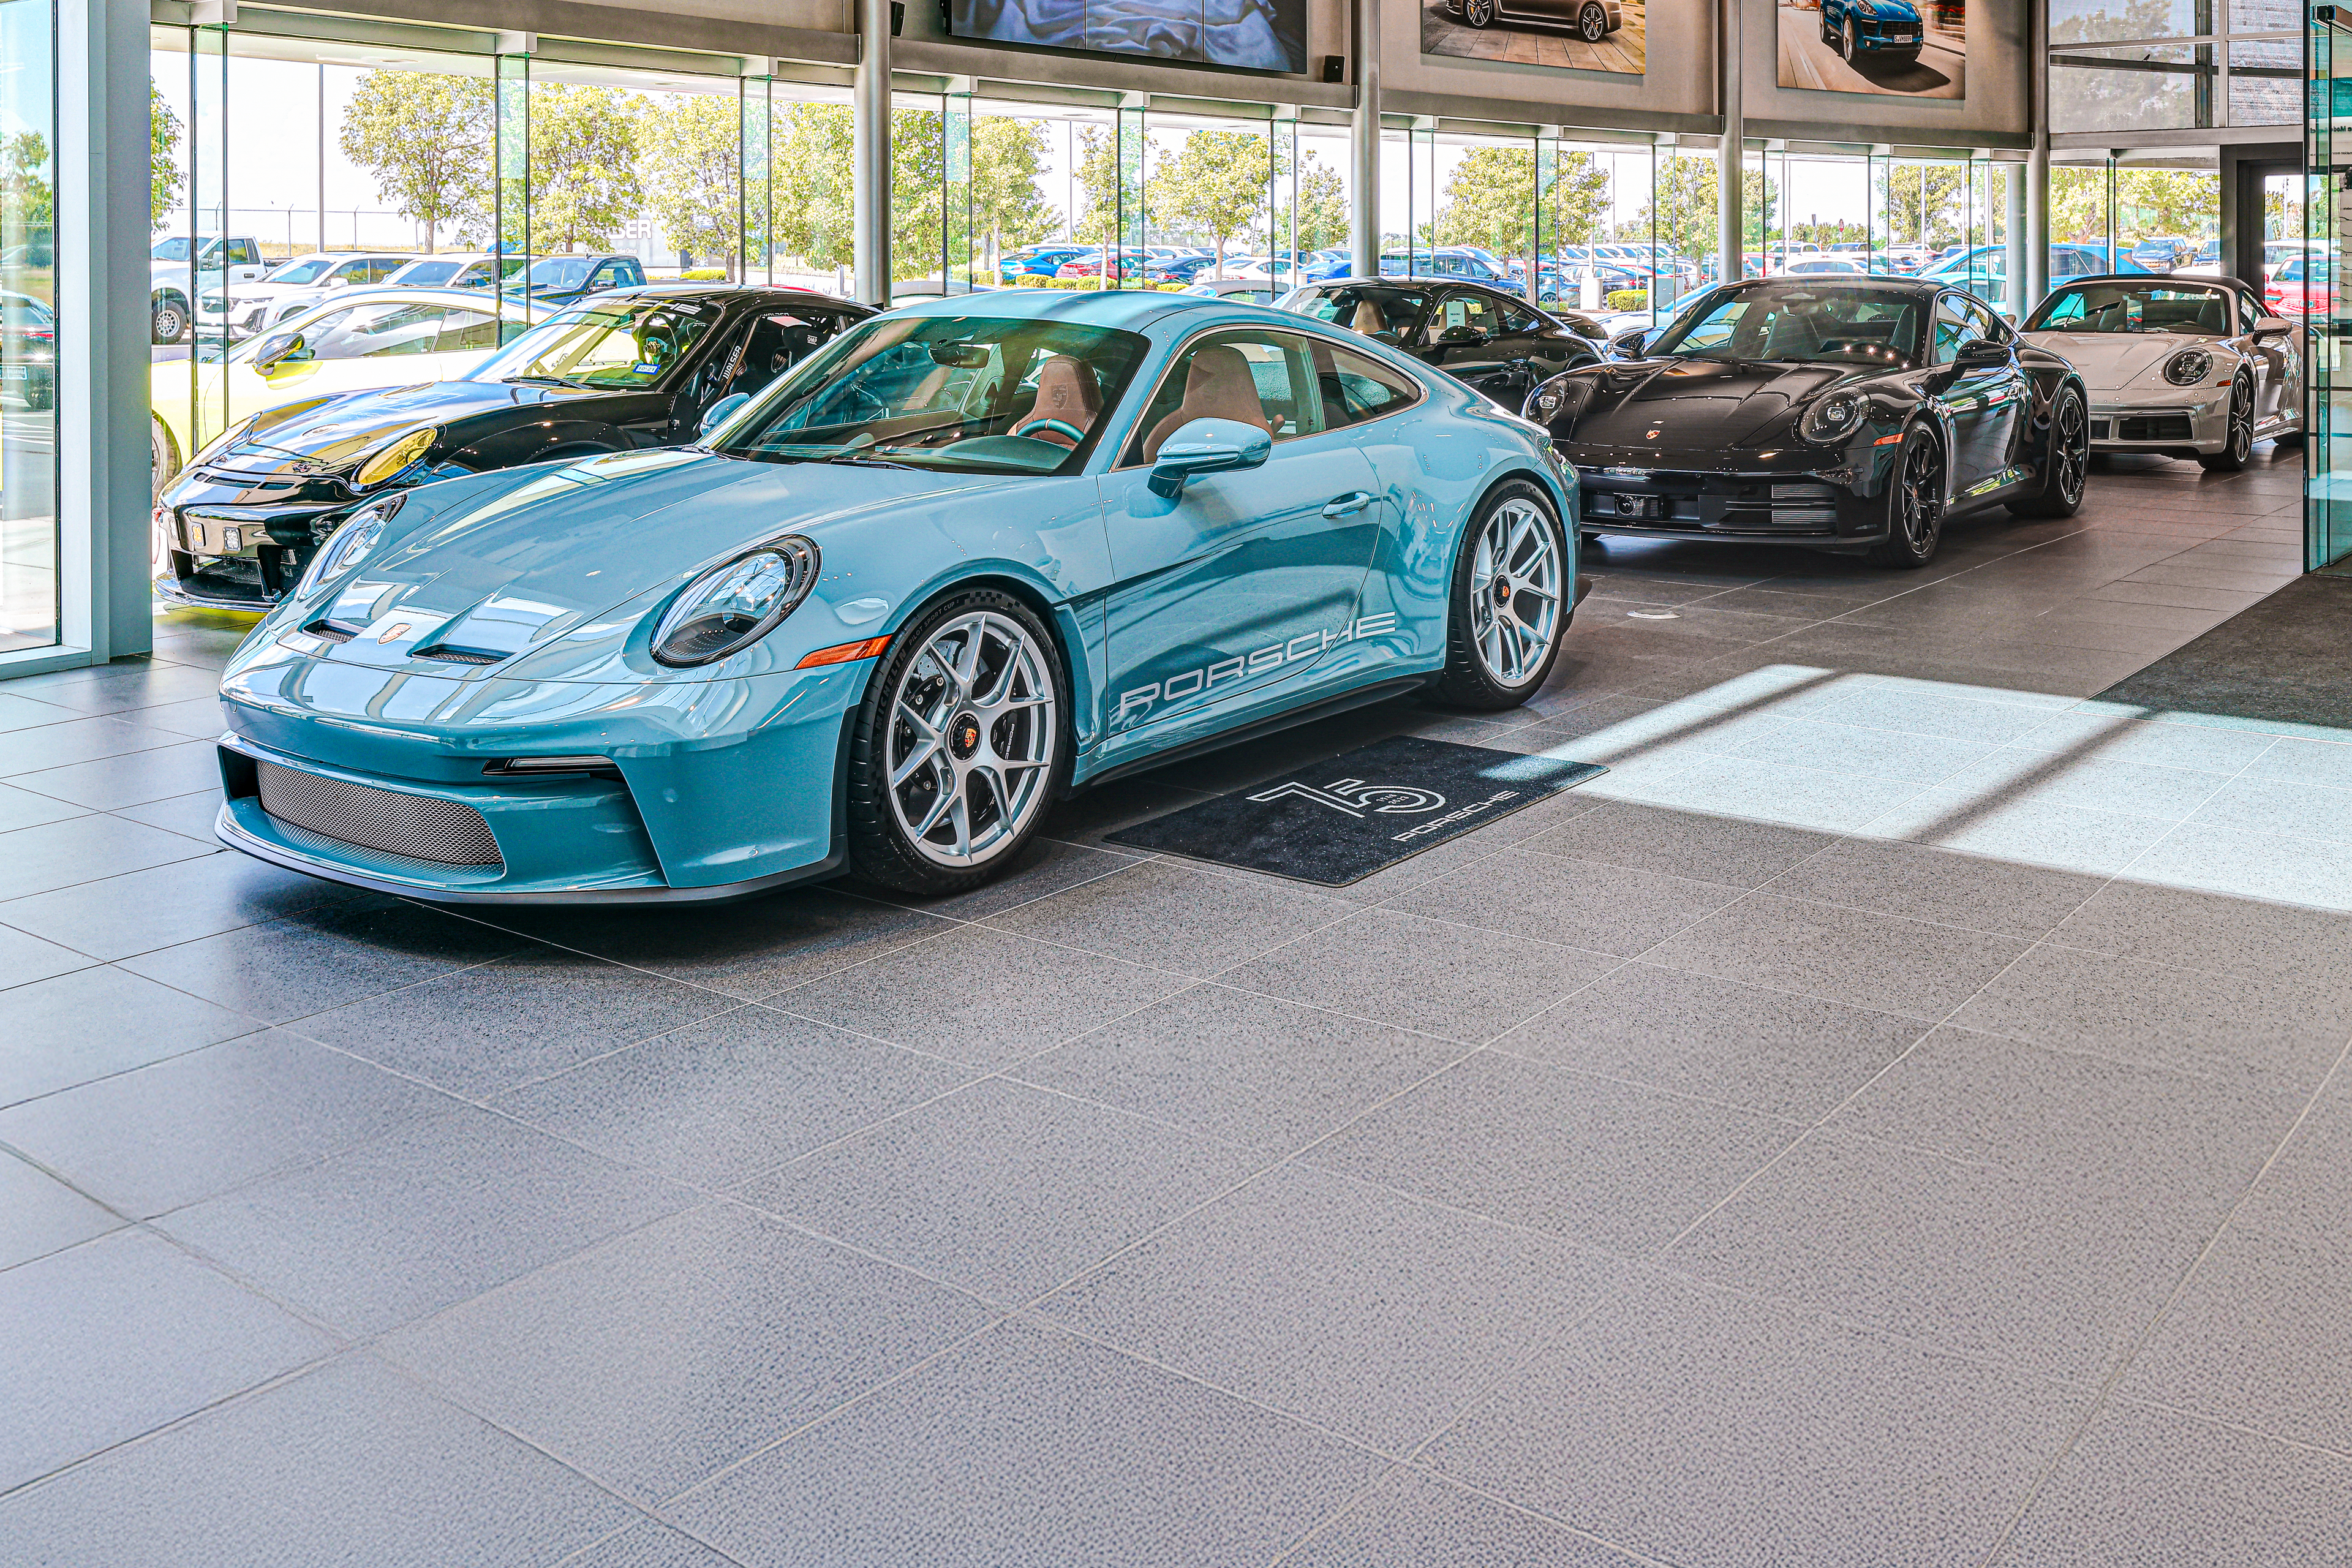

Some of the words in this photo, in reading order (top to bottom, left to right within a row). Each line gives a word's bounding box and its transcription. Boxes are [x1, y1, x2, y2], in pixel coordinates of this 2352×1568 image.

[722, 345, 742, 380] WALSER
[909, 625, 924, 646] PILOT
[924, 608, 942, 627] SPORT
[943, 601, 955, 611] CUP
[1120, 611, 1396, 717] PORSCHE
[875, 648, 907, 730] MICHELIN
[1005, 723, 1015, 760] PORSC
[1245, 778, 1446, 818] 75
[1390, 790, 1520, 843] PORSCHE
